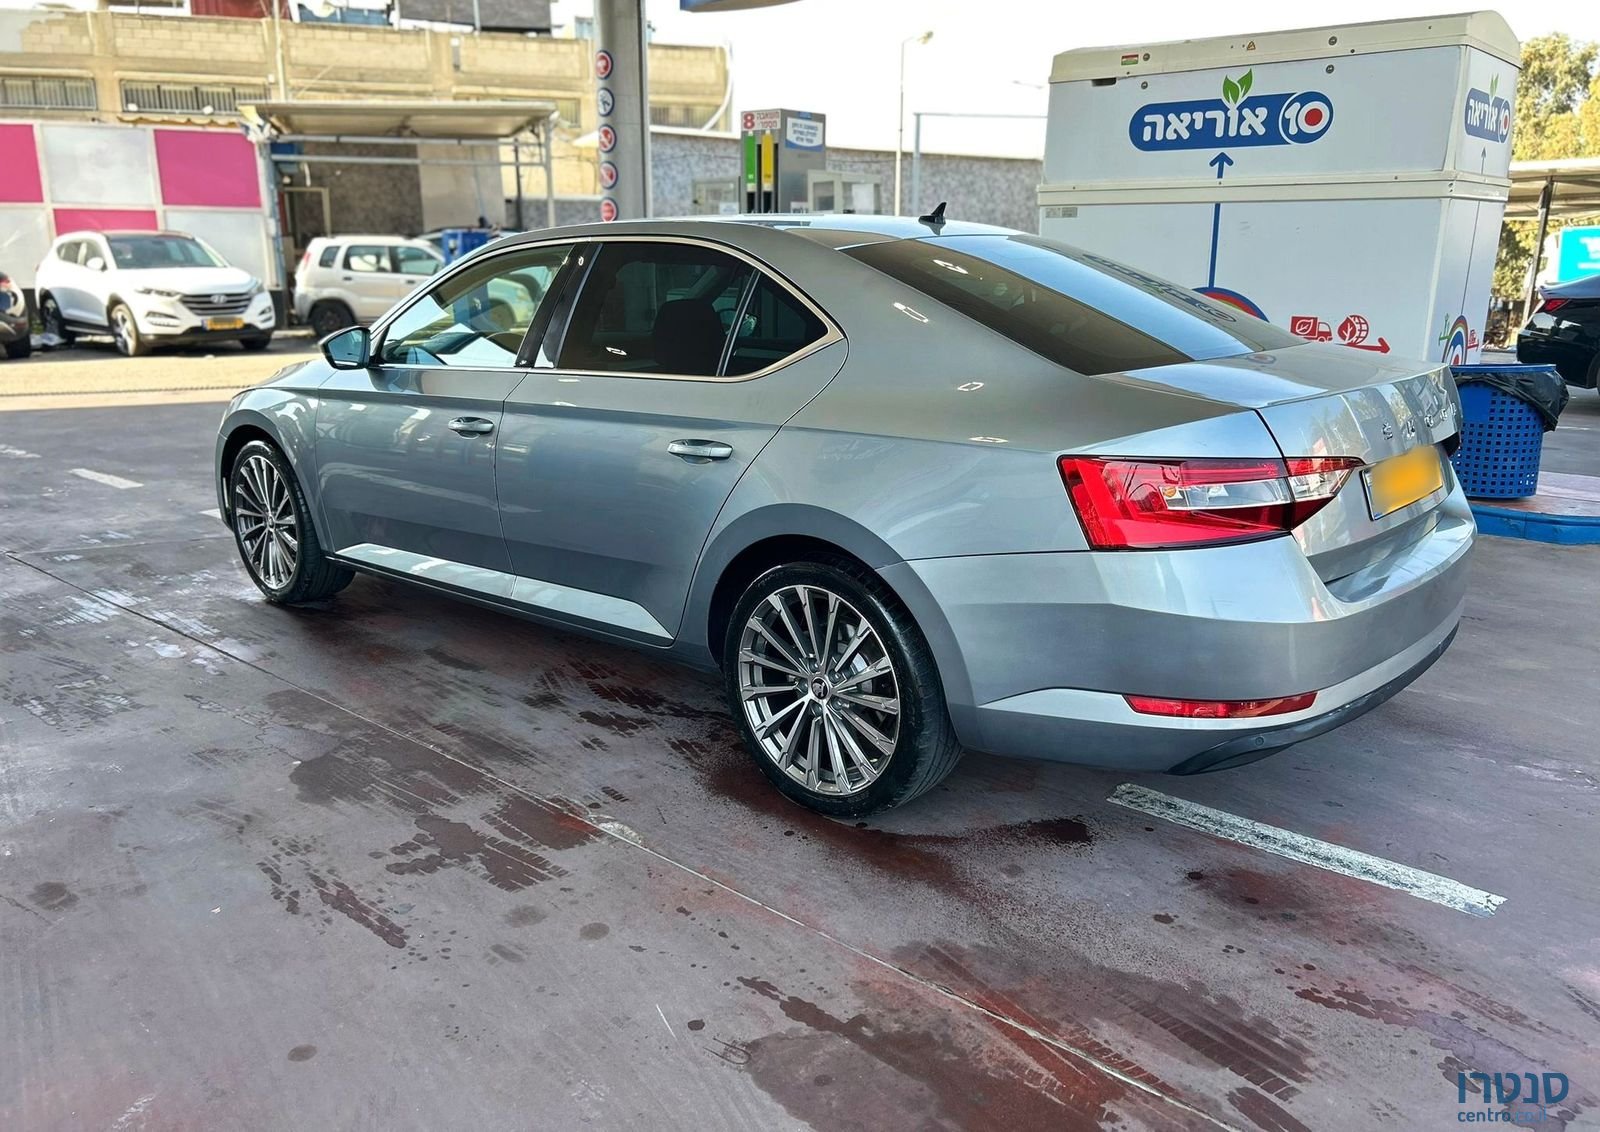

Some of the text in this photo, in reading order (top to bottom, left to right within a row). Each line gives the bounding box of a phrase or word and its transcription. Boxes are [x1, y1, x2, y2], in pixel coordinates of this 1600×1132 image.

[743, 112, 755, 129] 8
[1142, 101, 1330, 142] 10 אוריאה
[1467, 98, 1498, 132] אוריאה
